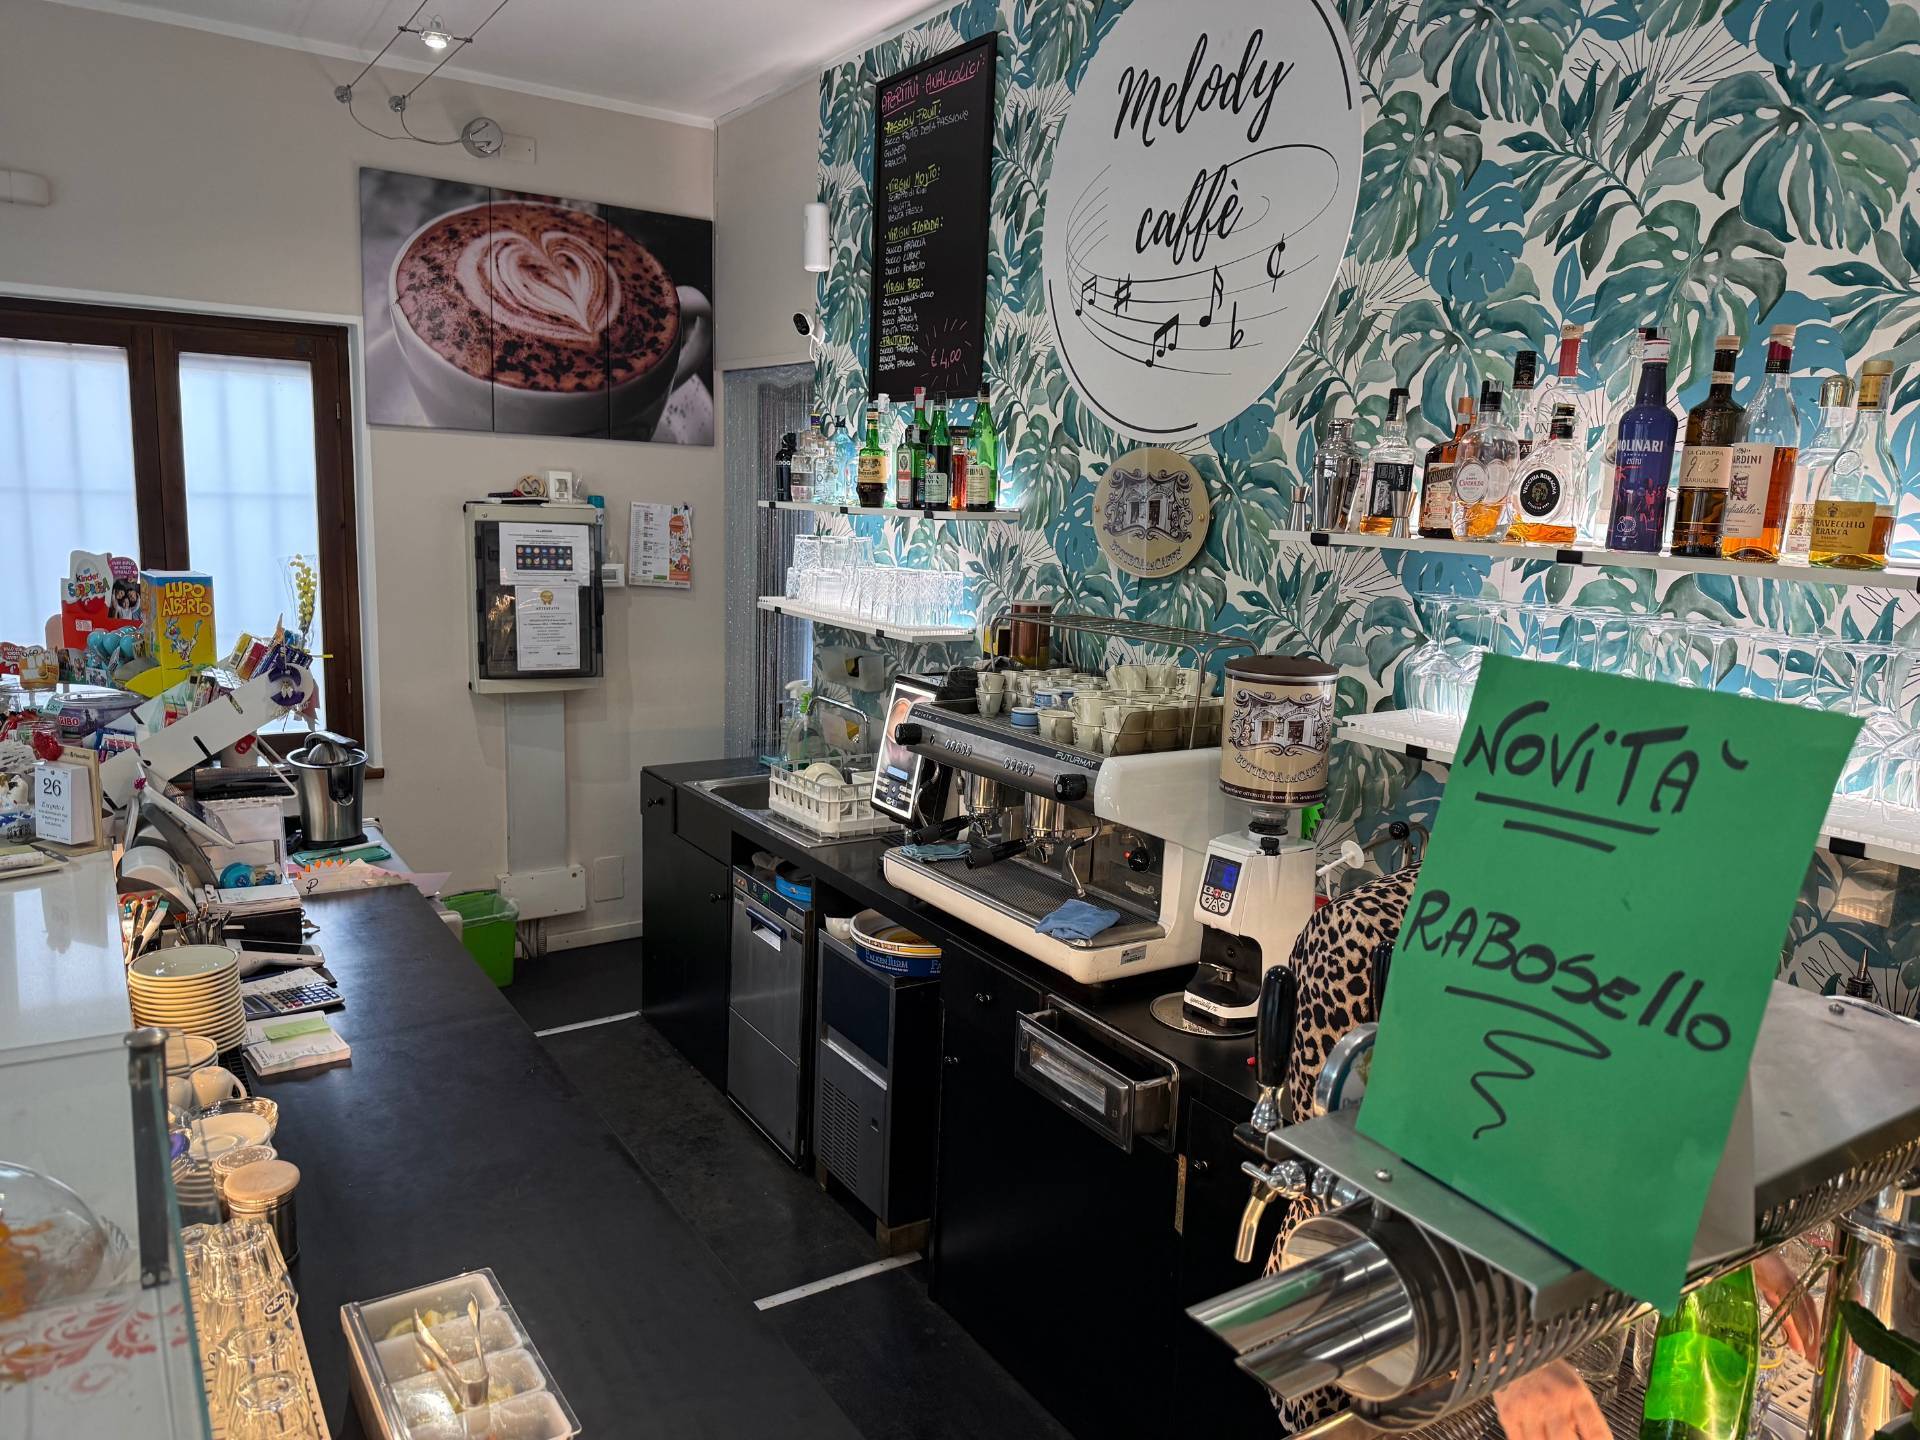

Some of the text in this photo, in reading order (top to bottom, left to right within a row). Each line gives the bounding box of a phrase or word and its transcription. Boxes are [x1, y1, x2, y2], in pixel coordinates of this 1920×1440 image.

[1114, 29, 1294, 147] Melody
[1135, 164, 1244, 266] caffè
[165, 581, 206, 599] LUPO
[161, 597, 213, 617] ALBERTO
[1055, 750, 1097, 770] FUTURMAT
[43, 777, 62, 797] 26
